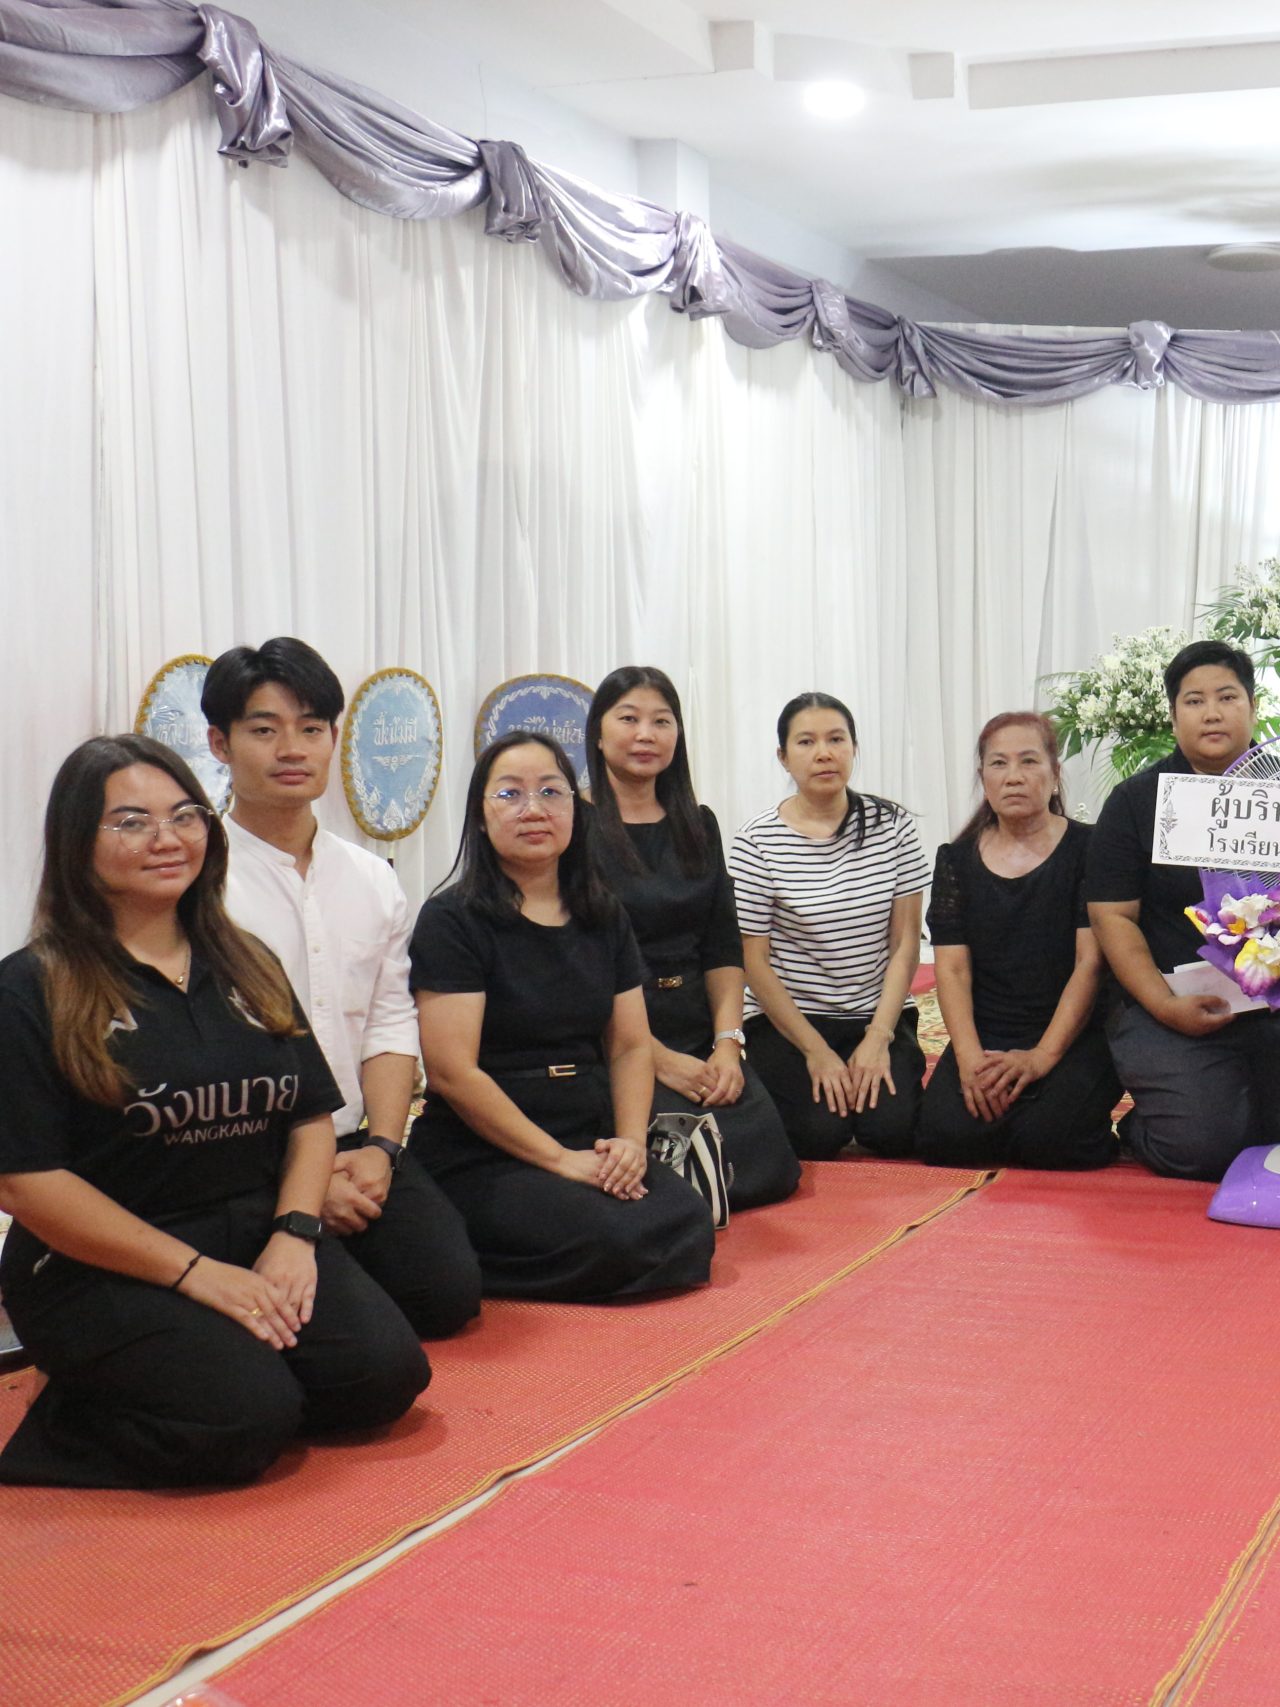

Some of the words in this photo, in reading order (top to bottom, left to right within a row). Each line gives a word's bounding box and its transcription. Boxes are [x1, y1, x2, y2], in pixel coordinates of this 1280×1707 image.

[123, 1074, 299, 1137] วังขนาย
[163, 1118, 269, 1146] WANGKANAI
